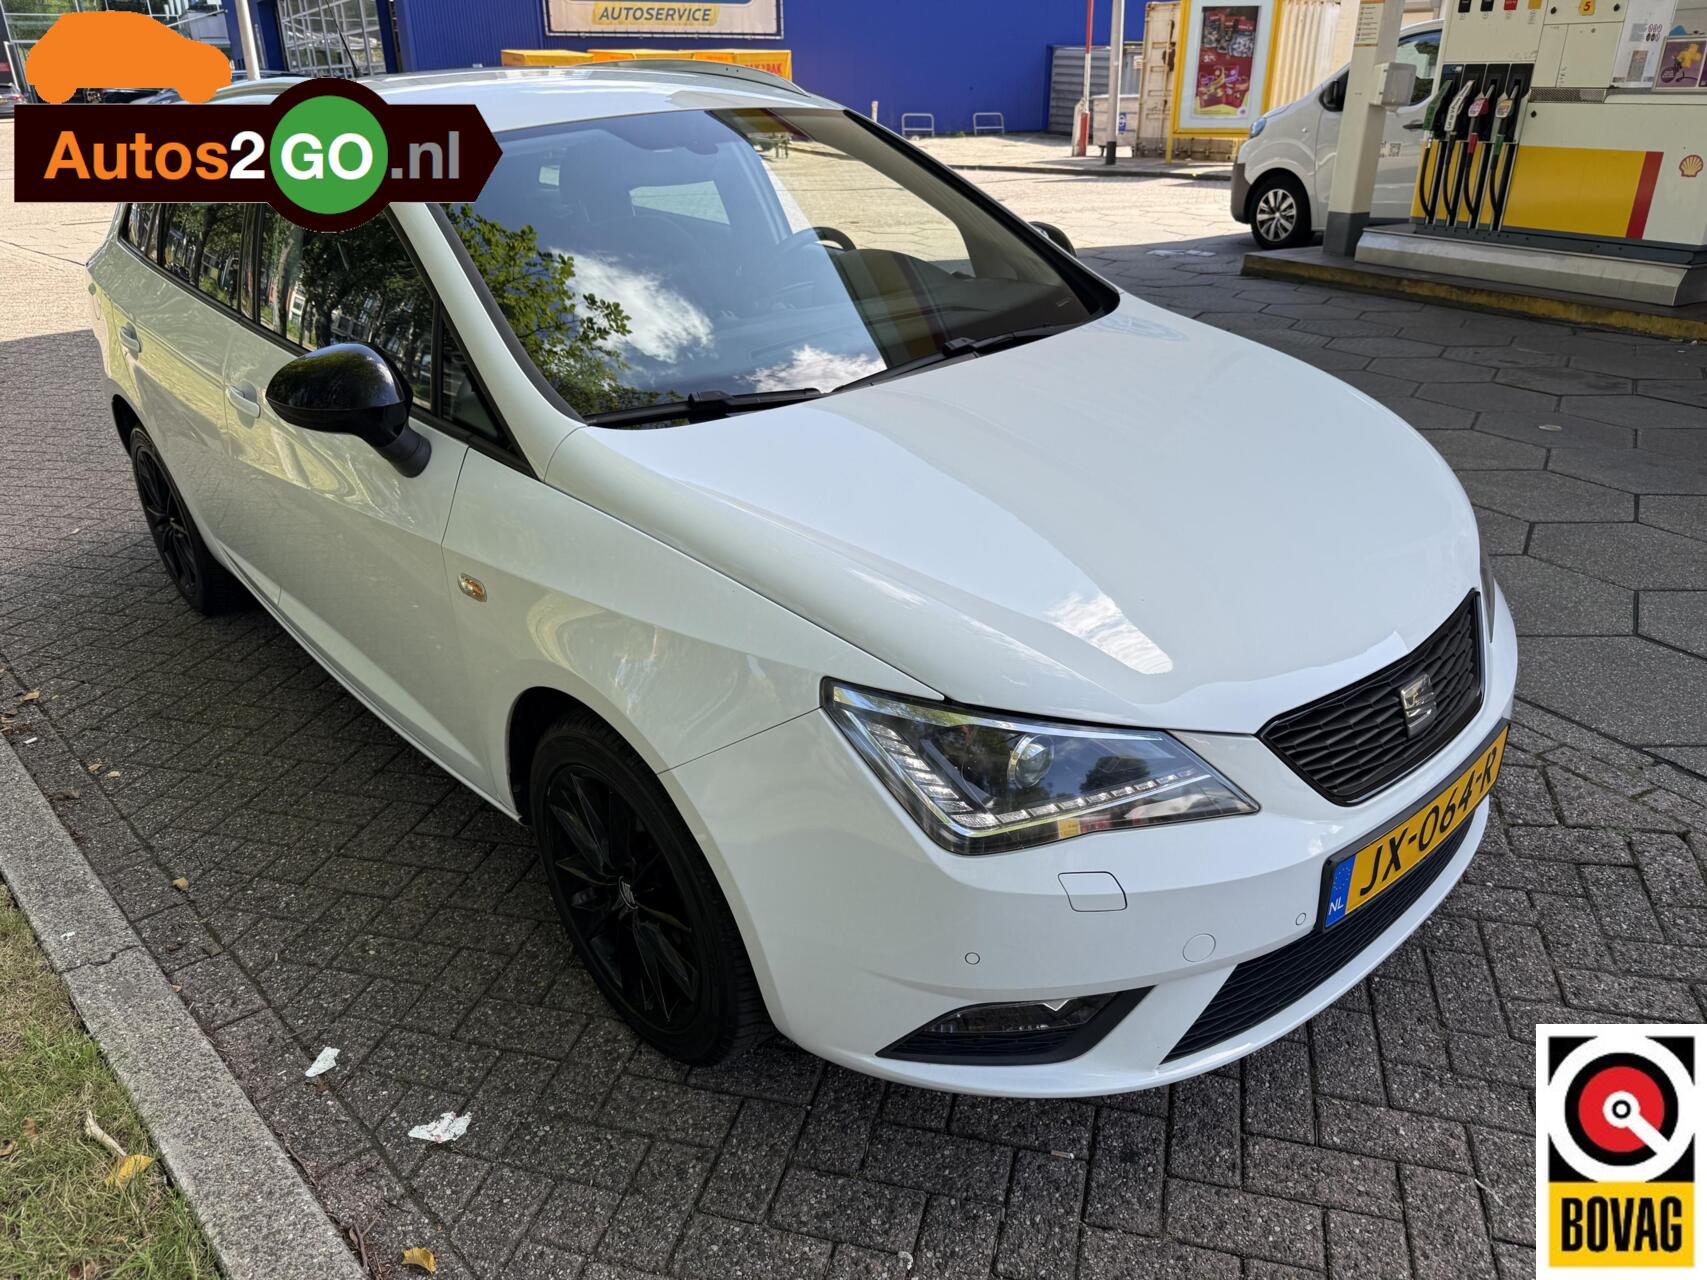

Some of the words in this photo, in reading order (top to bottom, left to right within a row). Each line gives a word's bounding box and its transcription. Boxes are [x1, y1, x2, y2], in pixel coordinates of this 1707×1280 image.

[599, 7, 712, 21] AUTOSERVICE
[1583, 1, 1592, 11] 5
[1359, 746, 1498, 896] JX-064-R
[1328, 896, 1344, 915] NL
